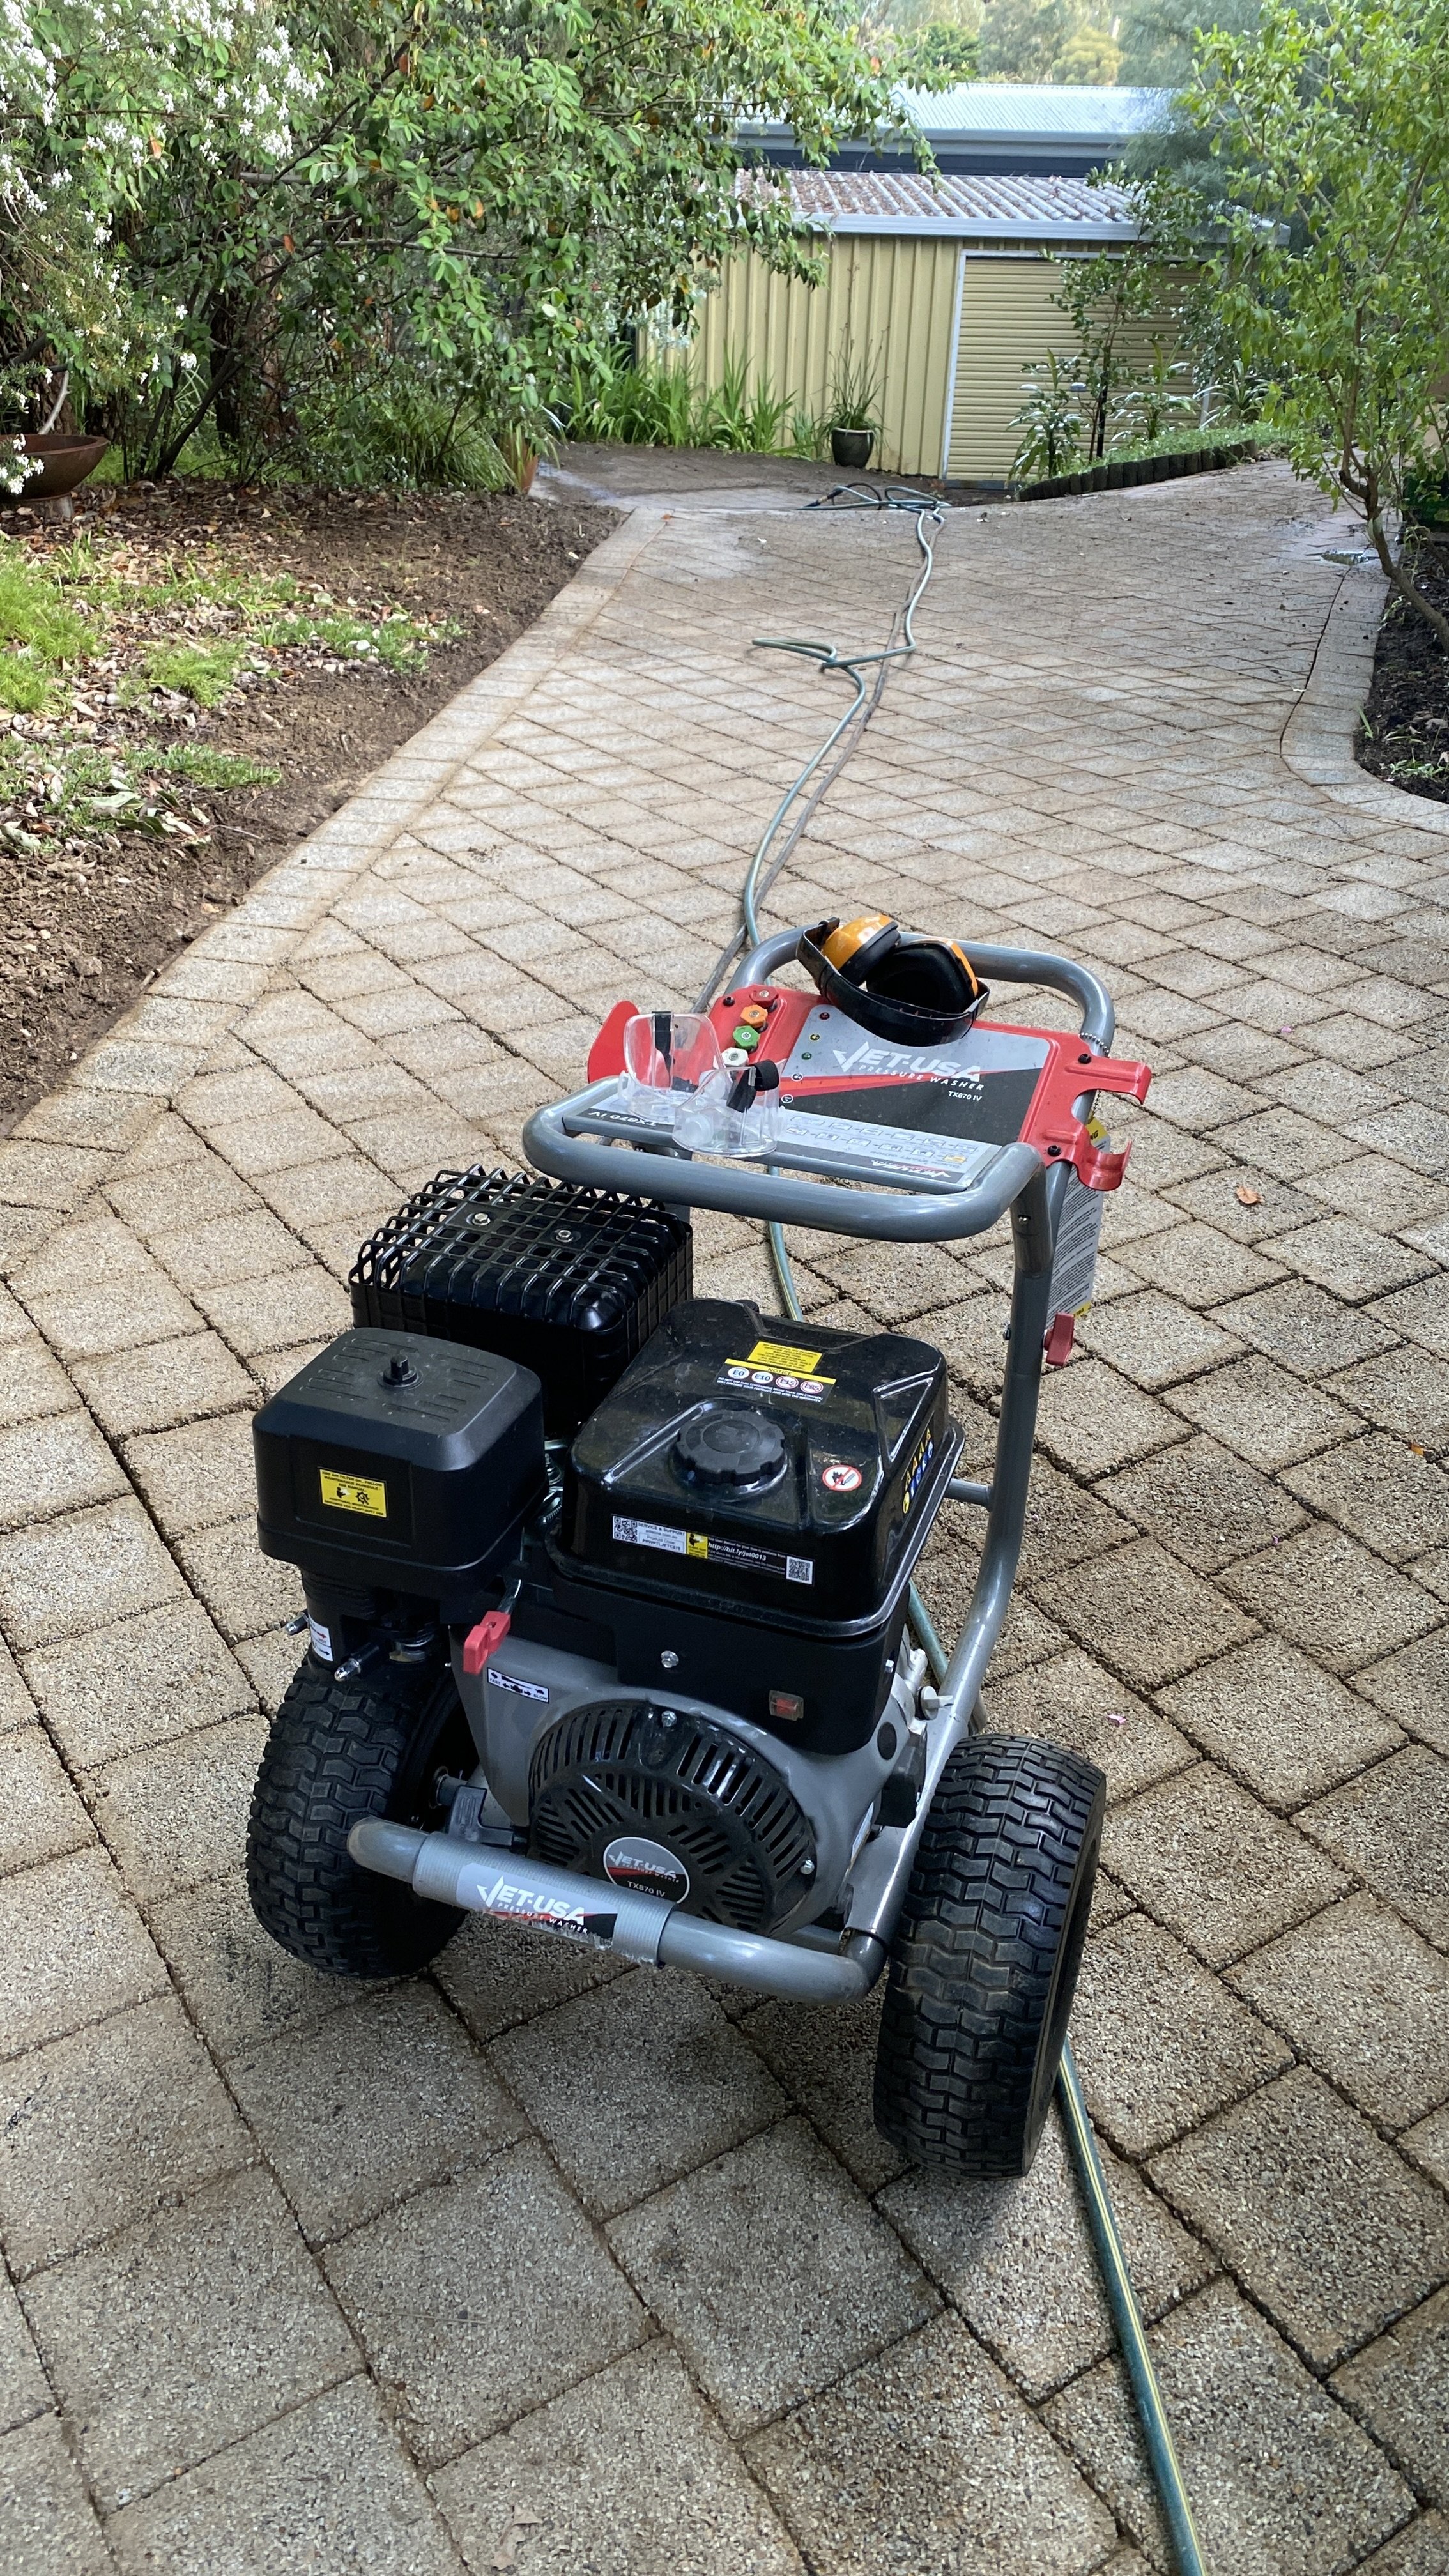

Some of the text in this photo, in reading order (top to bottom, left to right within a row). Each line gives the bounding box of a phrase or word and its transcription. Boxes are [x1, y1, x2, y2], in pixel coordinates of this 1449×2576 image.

[858, 1064, 985, 1091] PRESSURE WASHER
[948, 1091, 972, 1100] TX870
[627, 1880, 666, 1897] TX870 IV
